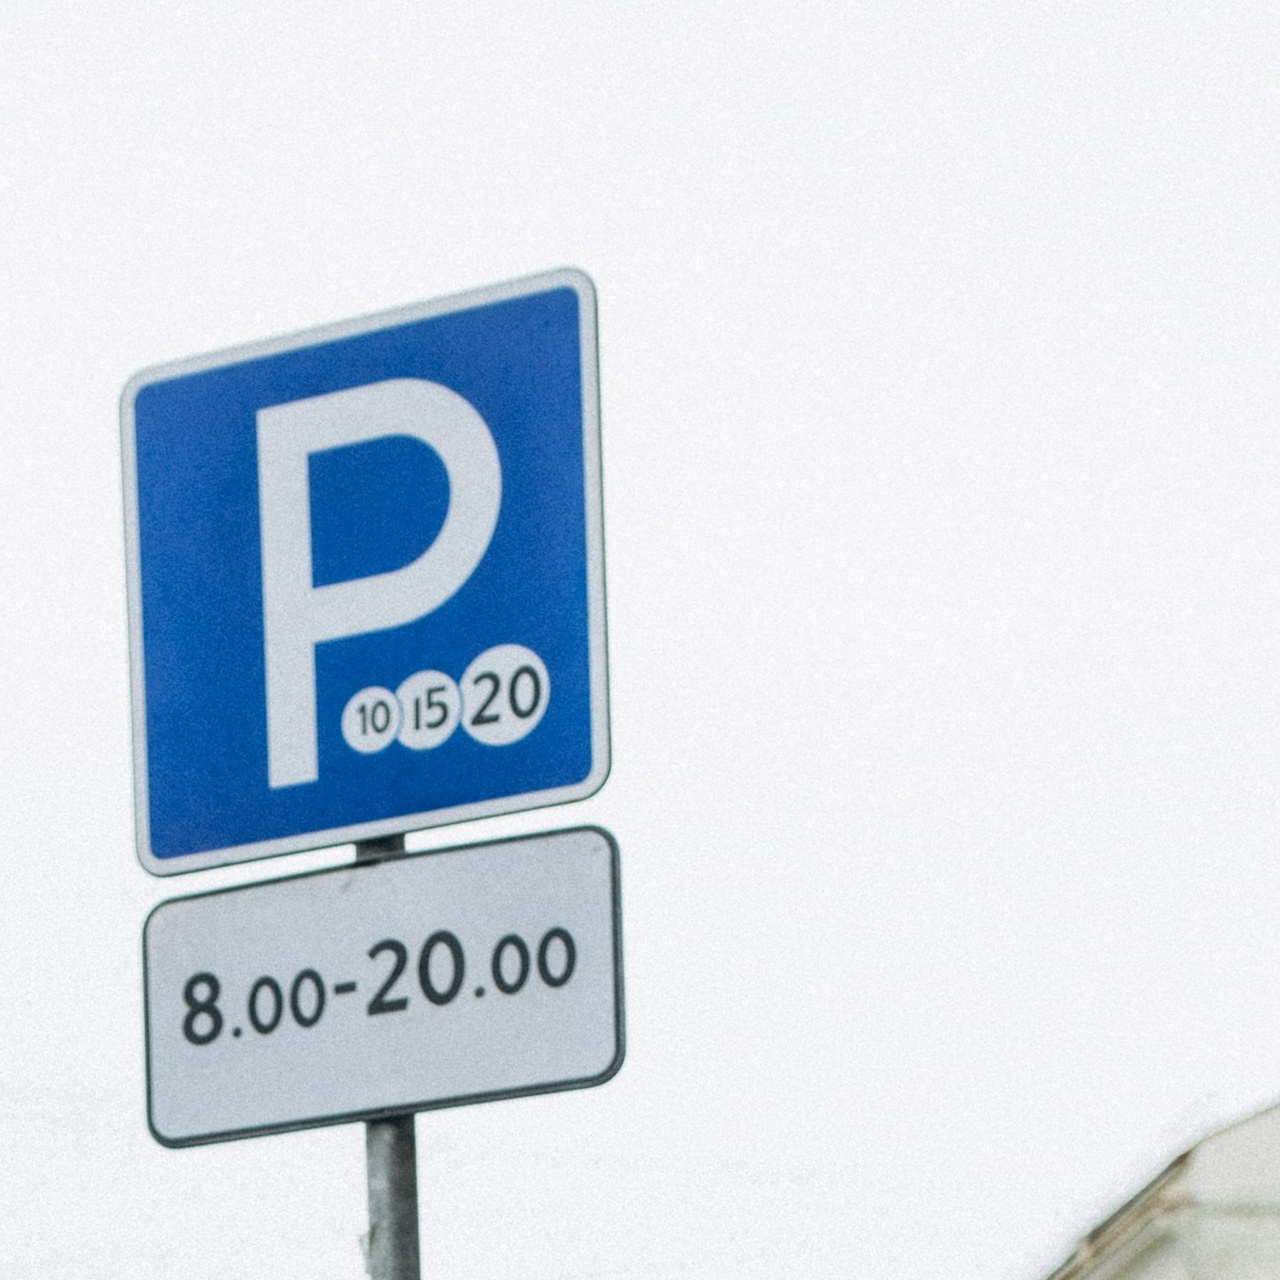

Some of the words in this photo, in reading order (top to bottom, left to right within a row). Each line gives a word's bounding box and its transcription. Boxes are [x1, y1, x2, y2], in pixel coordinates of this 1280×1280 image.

[256, 377, 502, 789] P
[357, 699, 391, 735] 10
[414, 685, 449, 731] 15
[470, 664, 542, 727] 20
[181, 926, 577, 1047] 8.00-20.00
